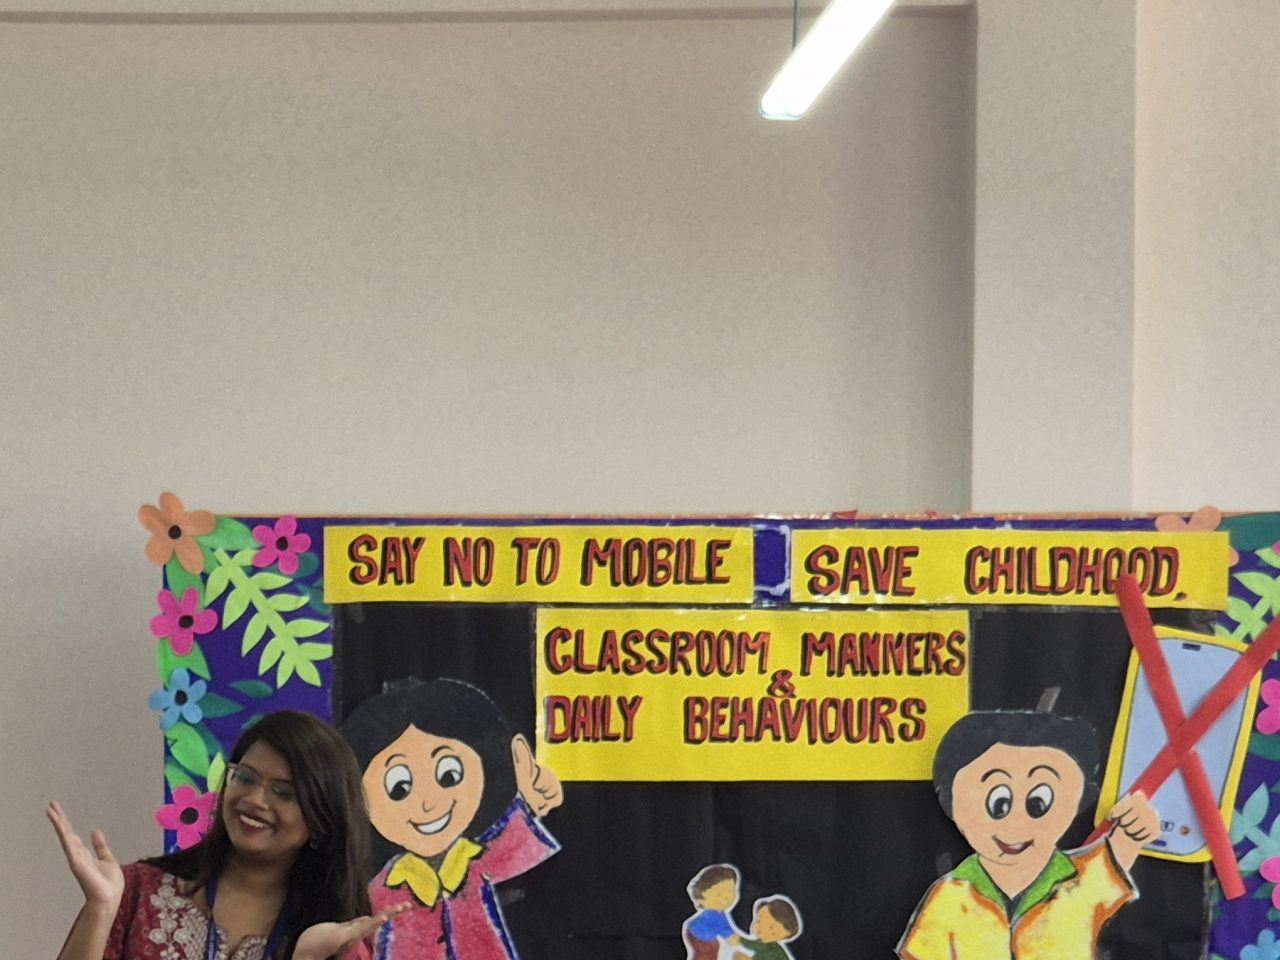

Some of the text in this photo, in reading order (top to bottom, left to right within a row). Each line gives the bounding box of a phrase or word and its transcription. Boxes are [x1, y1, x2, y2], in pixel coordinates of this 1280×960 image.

[349, 533, 731, 586] SAY NO TO MOBILE
[805, 545, 919, 596] SAVE
[545, 627, 967, 677] CLASSROOM MANNERS
[769, 669, 797, 698] &
[546, 695, 928, 745] DAILY BEHAVIOURS
